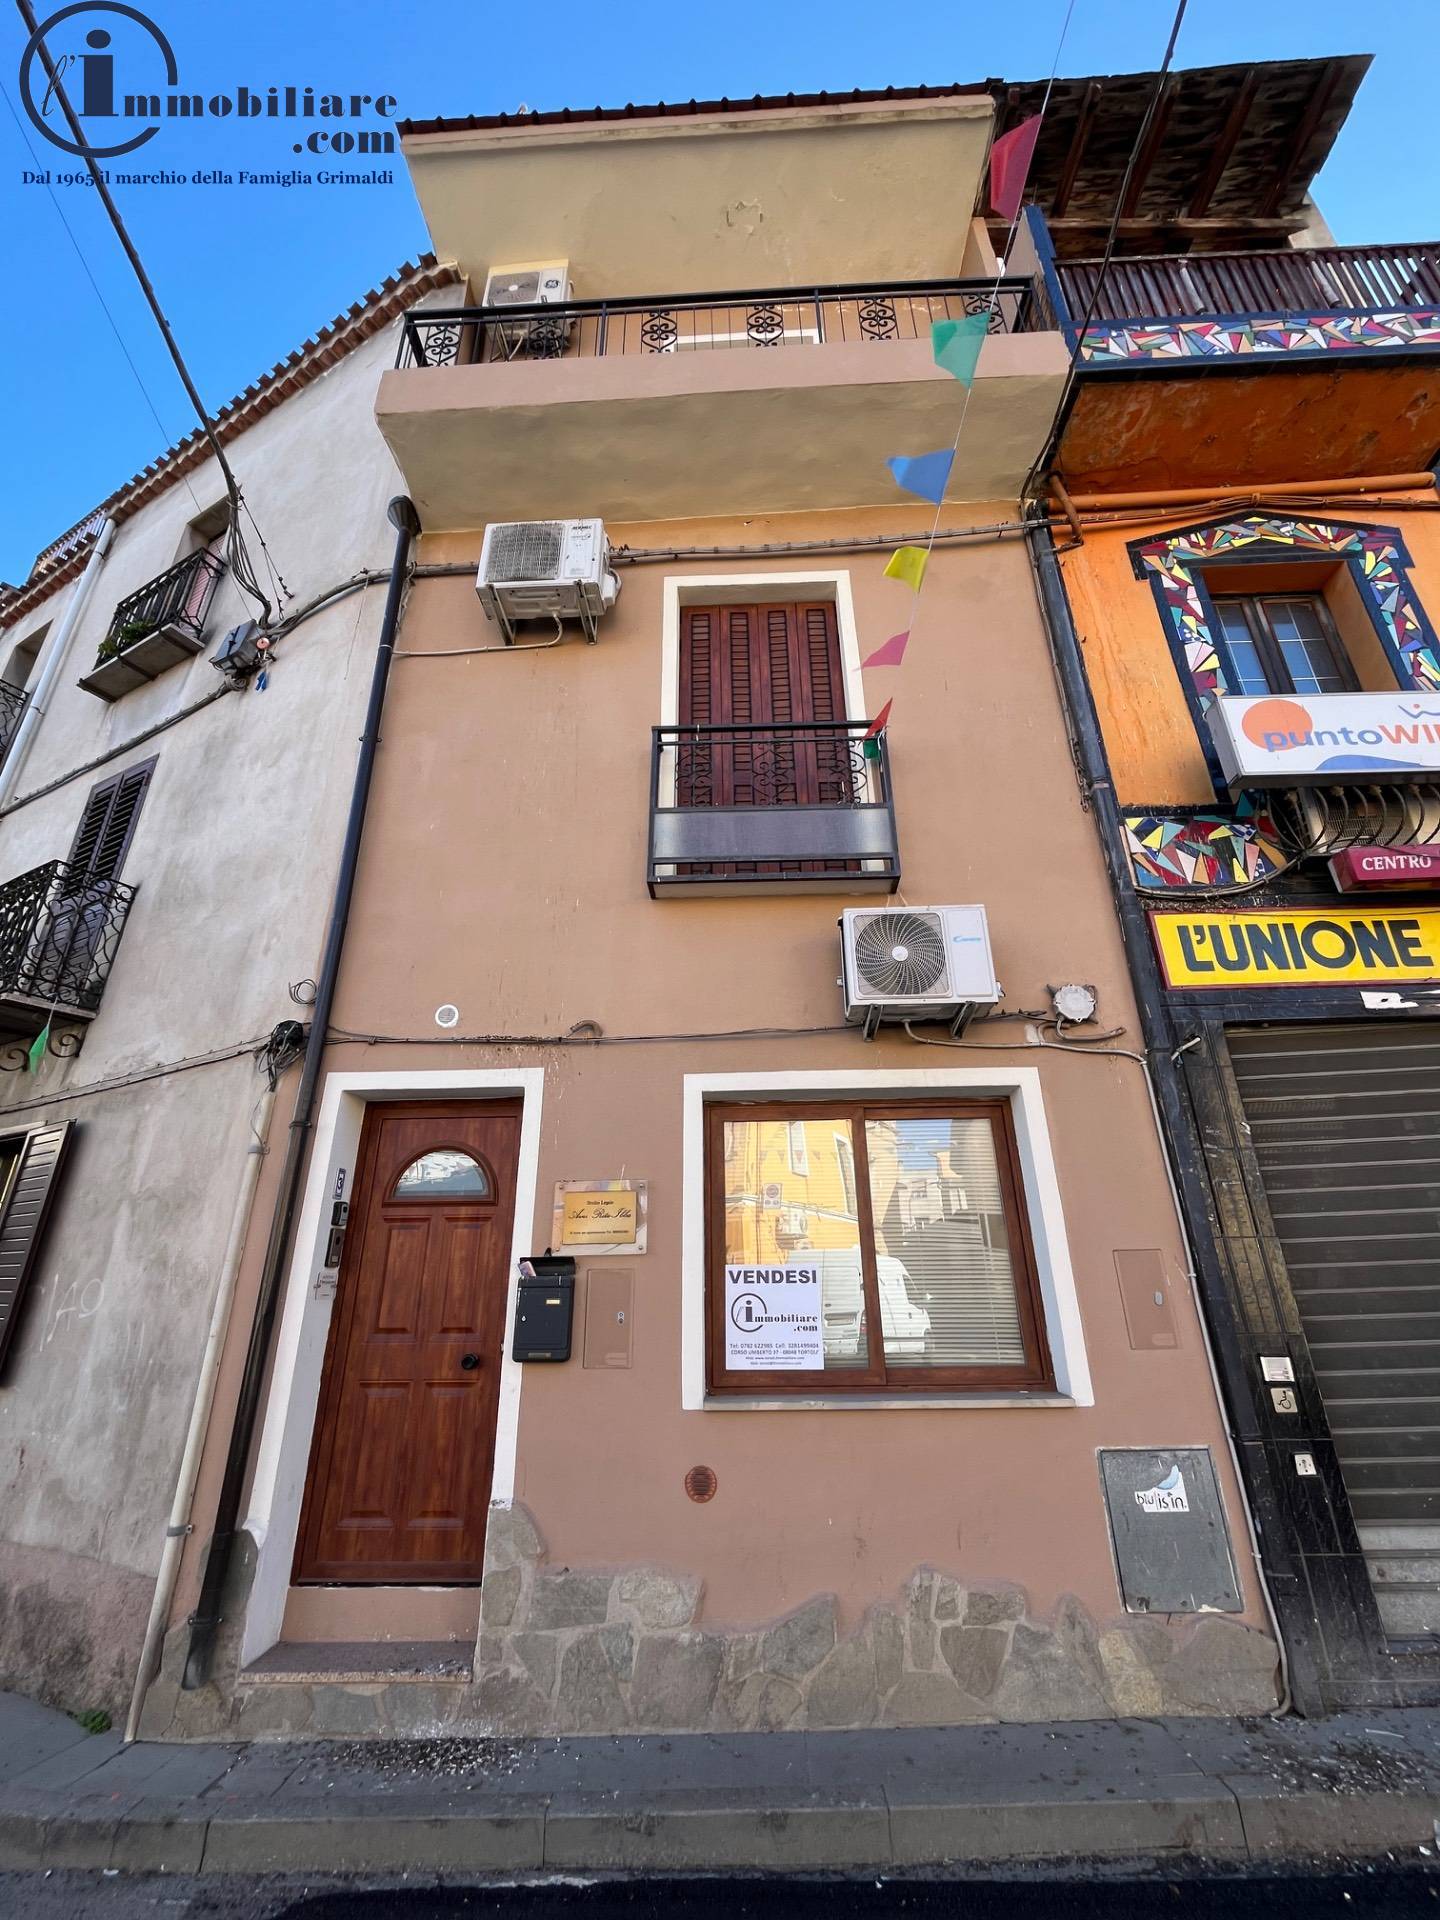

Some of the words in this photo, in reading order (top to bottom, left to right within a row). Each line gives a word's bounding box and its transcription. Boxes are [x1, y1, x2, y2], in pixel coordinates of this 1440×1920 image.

[1262, 723, 1440, 753] puntoWI
[1362, 855, 1432, 871] CENTRO
[1176, 919, 1434, 972] L'UNIONE
[728, 1269, 817, 1284] VENDESI
